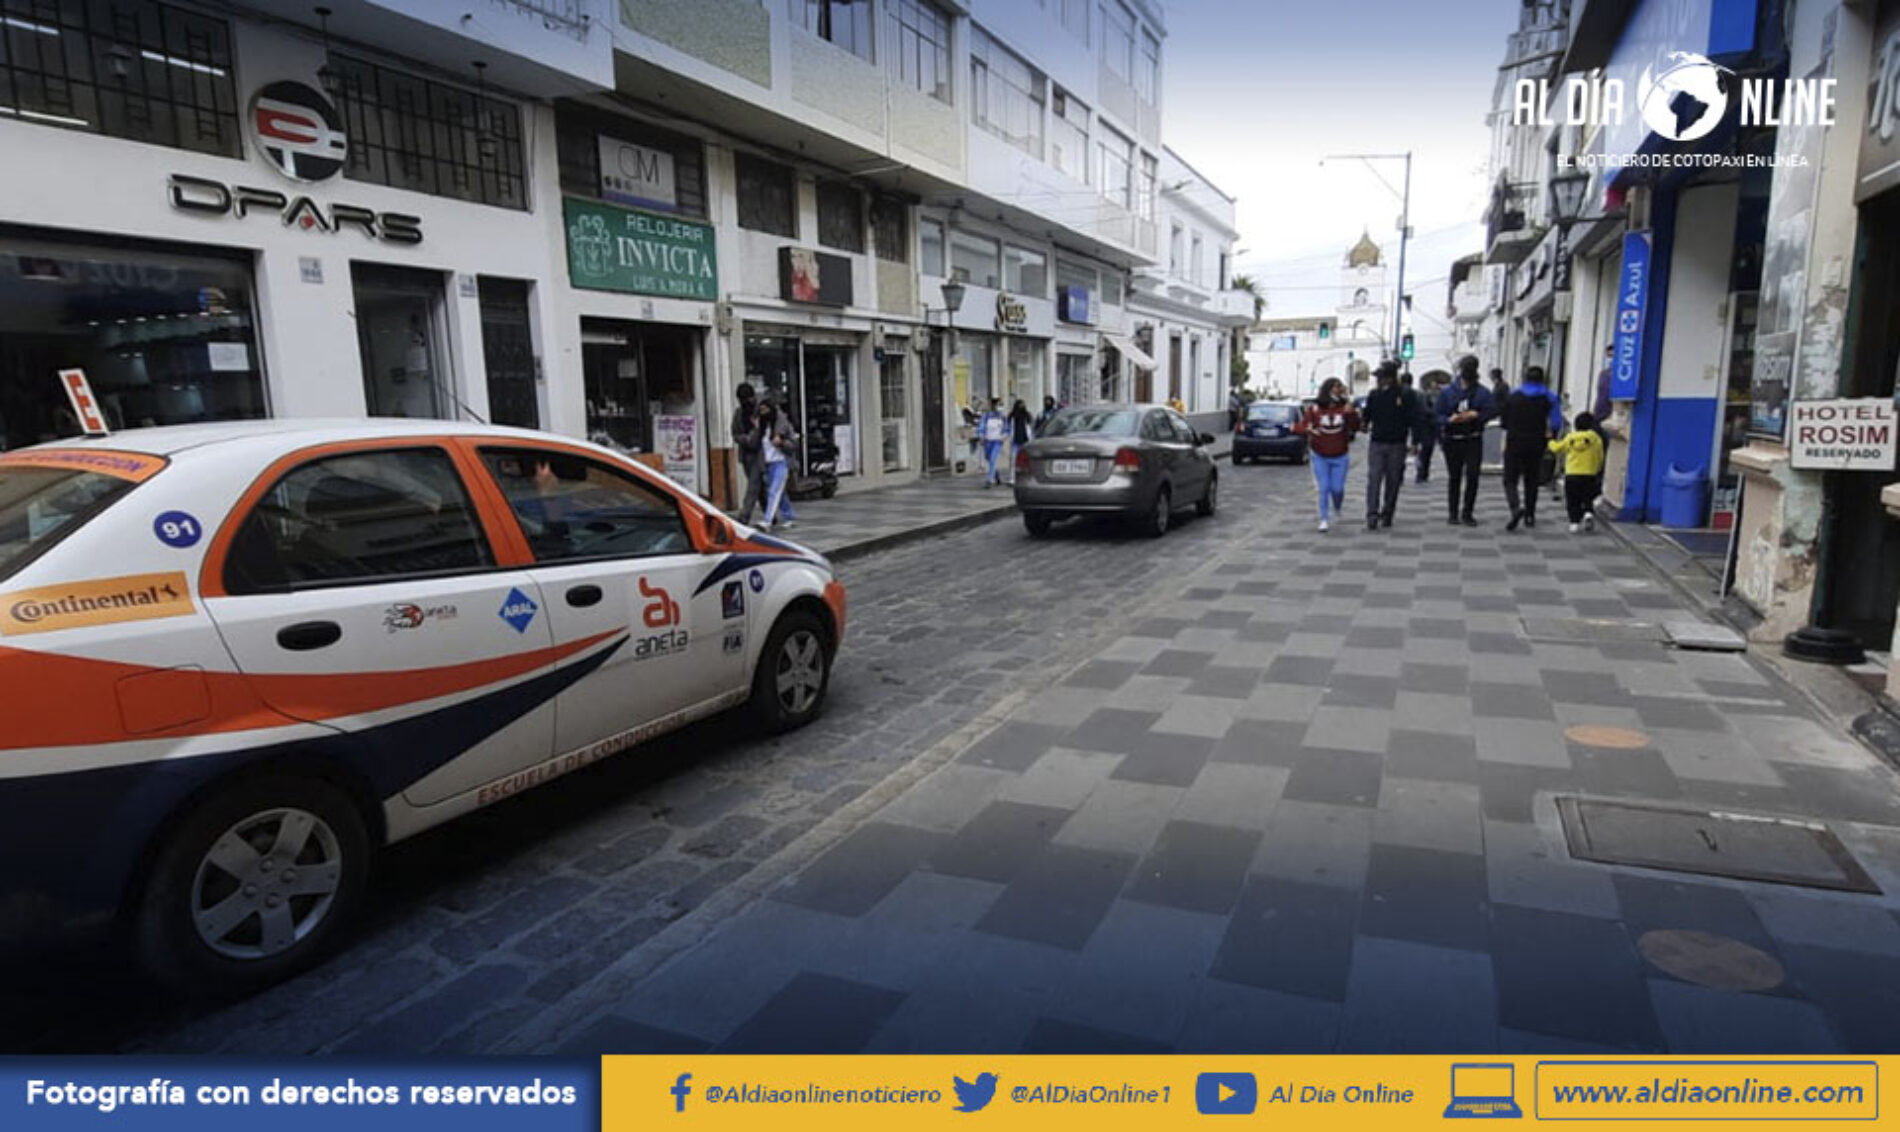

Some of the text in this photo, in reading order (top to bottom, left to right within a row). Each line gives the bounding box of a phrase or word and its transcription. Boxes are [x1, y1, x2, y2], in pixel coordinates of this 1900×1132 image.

[167, 172, 424, 245] DPARS
[617, 236, 713, 278] INVICTA
[1617, 260, 1643, 381] Cruz Azul
[1797, 405, 1891, 421] HOTEL
[1799, 425, 1889, 445] ROSIM
[1805, 446, 1881, 463] RESERVADO
[161, 520, 196, 540] 91
[10, 585, 159, 623] Continental
[503, 601, 534, 618] ARAL
[634, 630, 688, 656] aneta
[477, 762, 558, 805] ESCUELA
[563, 748, 588, 773] DE
